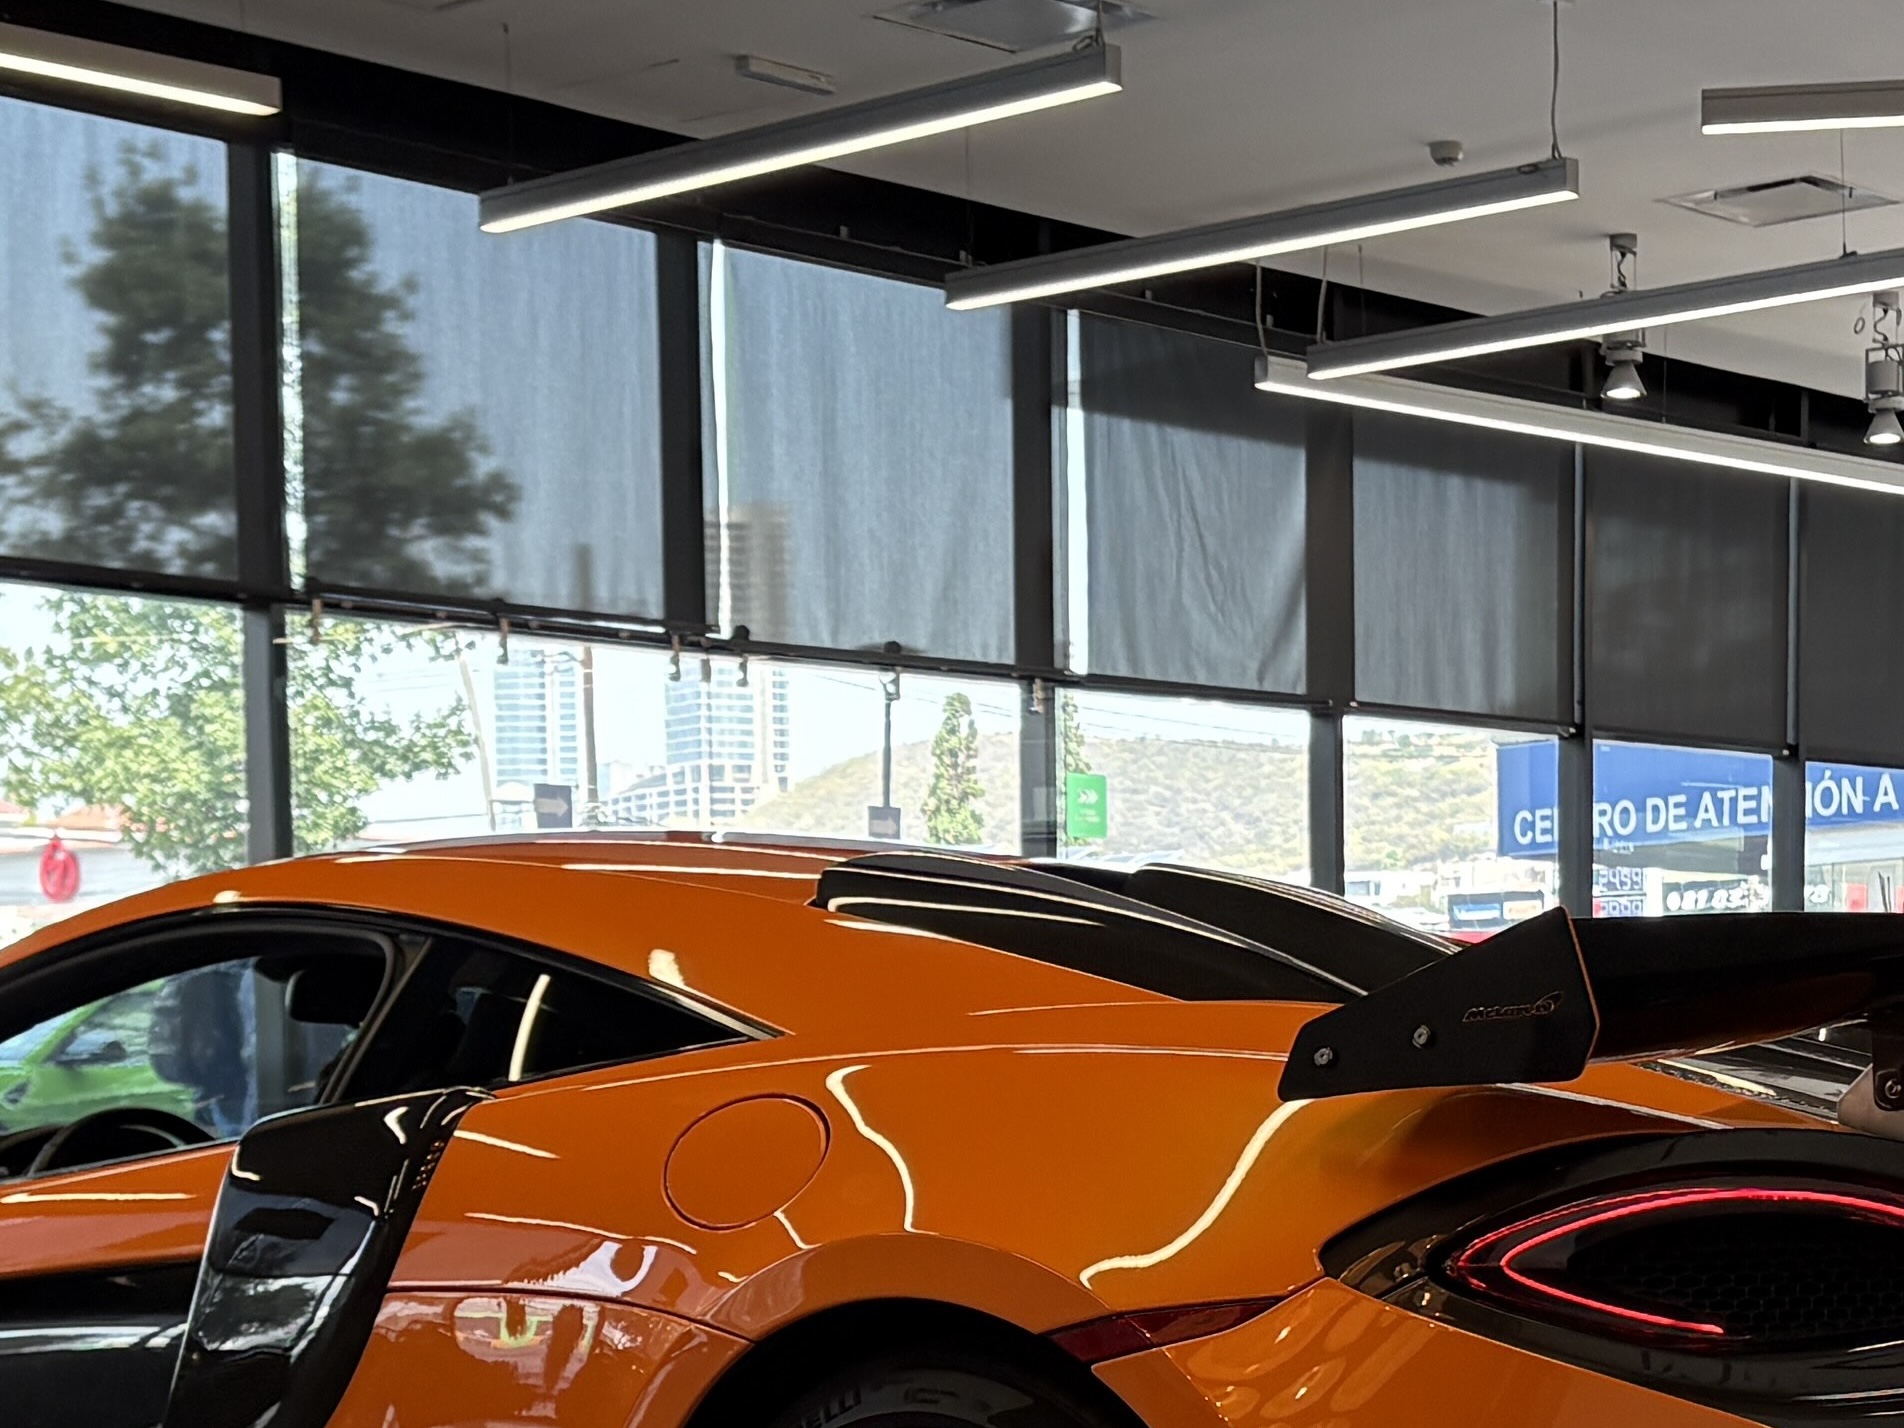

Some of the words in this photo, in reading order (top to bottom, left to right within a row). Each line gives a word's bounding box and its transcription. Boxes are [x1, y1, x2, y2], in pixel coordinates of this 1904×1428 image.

[1514, 799, 1637, 845] CERO
[1646, 794, 1688, 833] DE
[1874, 773, 1899, 813] A
